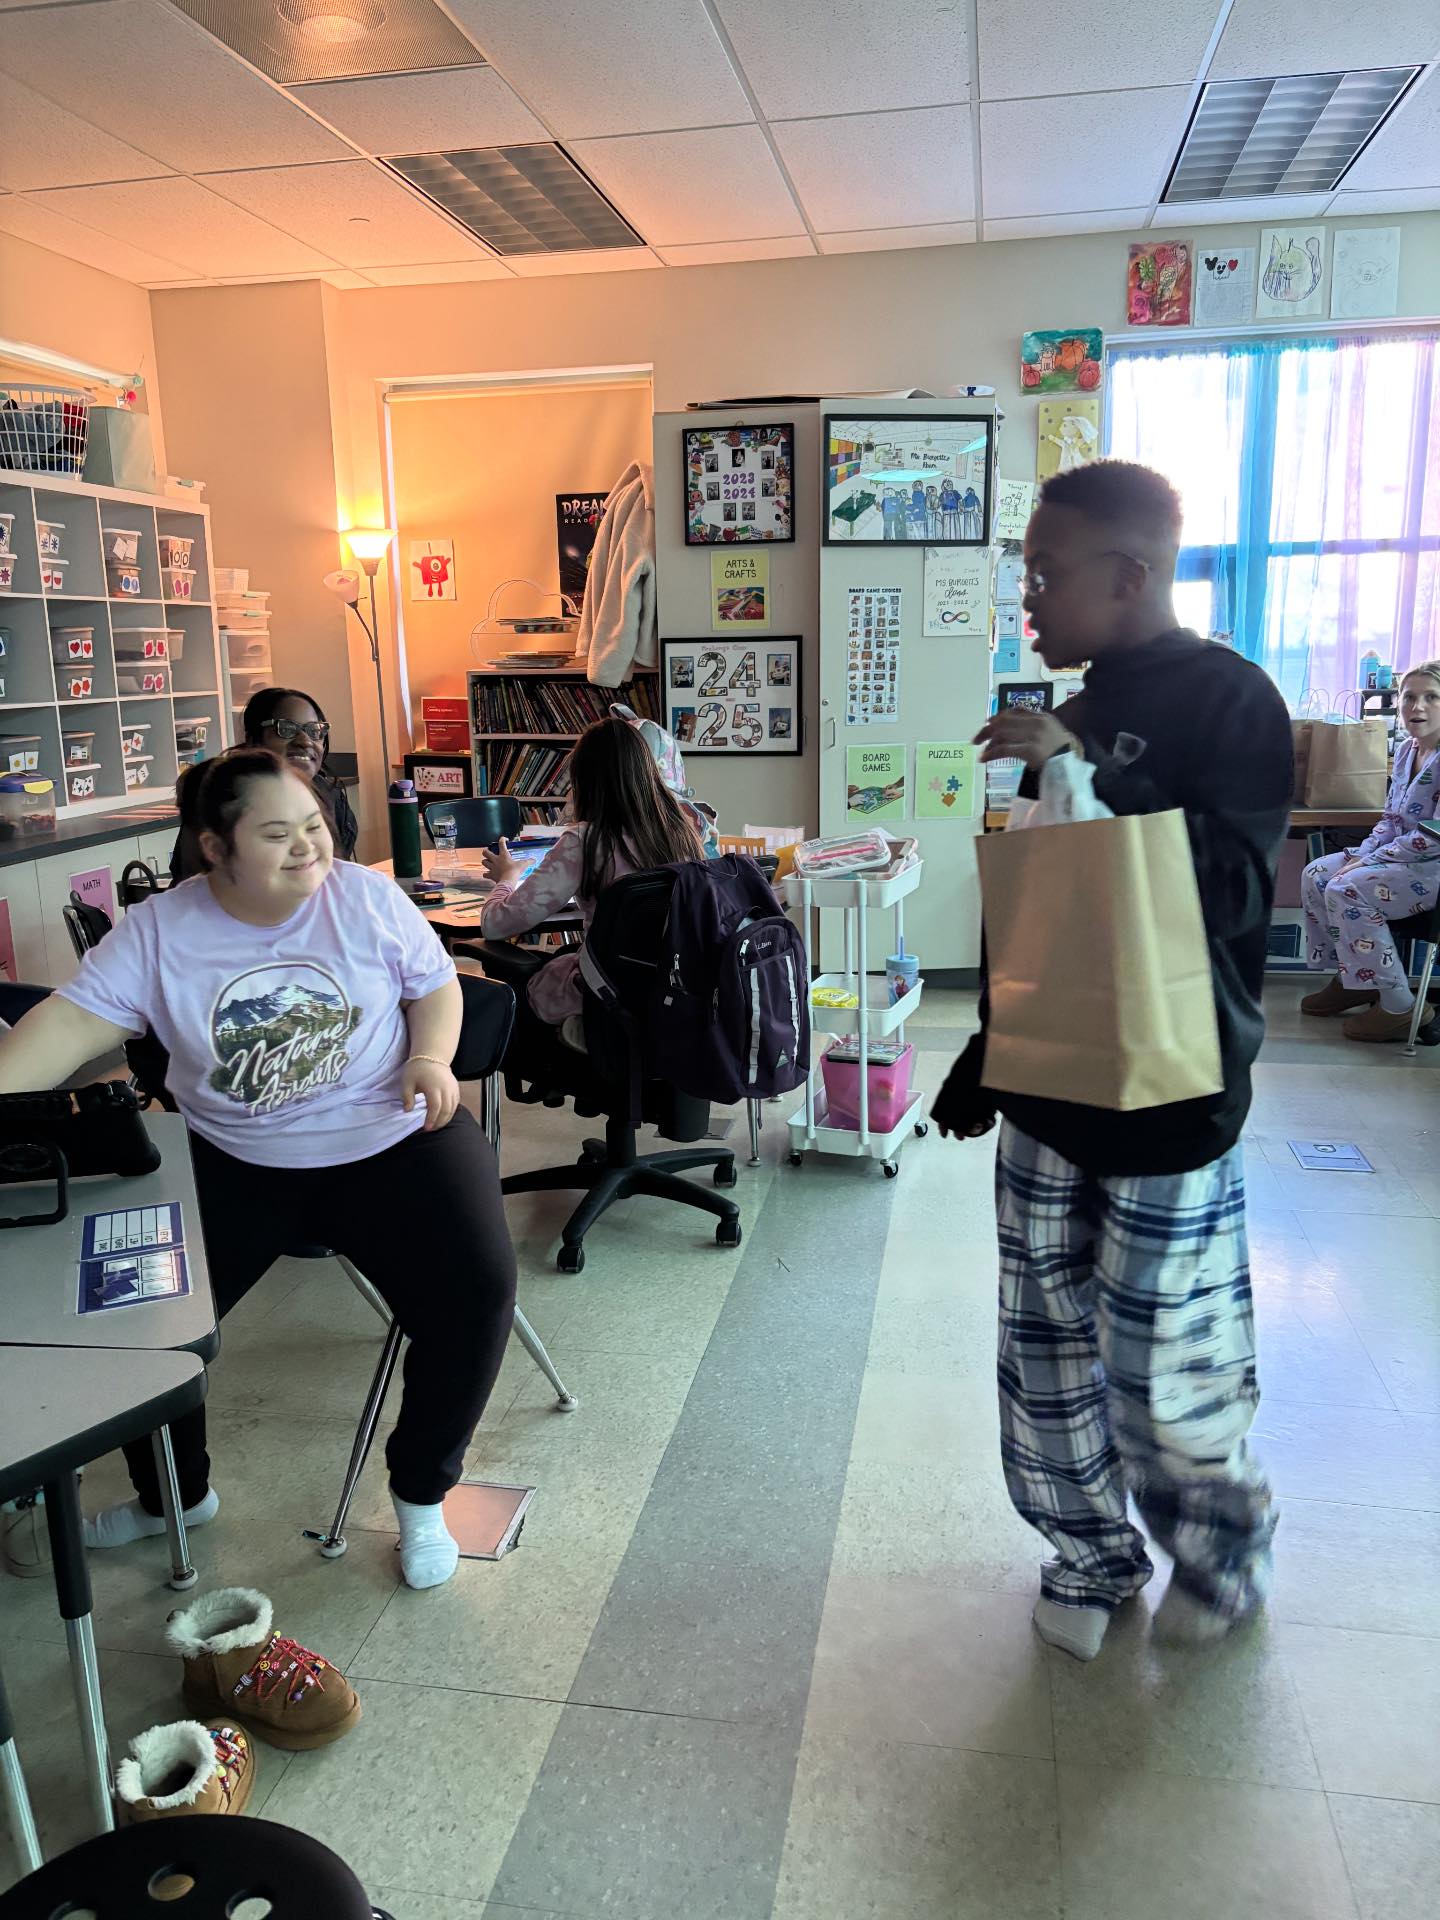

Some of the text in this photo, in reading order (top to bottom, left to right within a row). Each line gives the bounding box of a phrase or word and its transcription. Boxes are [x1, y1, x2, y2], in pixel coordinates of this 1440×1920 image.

[722, 472, 755, 485] 2023
[723, 487, 756, 500] 2024
[726, 559, 755, 568] ARTS &
[724, 569, 757, 579] CRAFTS
[697, 651, 761, 698] 24
[697, 702, 763, 748] 25
[862, 753, 891, 763] BOARD
[928, 749, 964, 759] PUZZLES
[861, 763, 891, 773] GAMES
[437, 772, 462, 784] ART
[82, 879, 102, 892] MATH
[226, 1021, 350, 1091] Nature
[246, 1043, 349, 1116] Awaits
